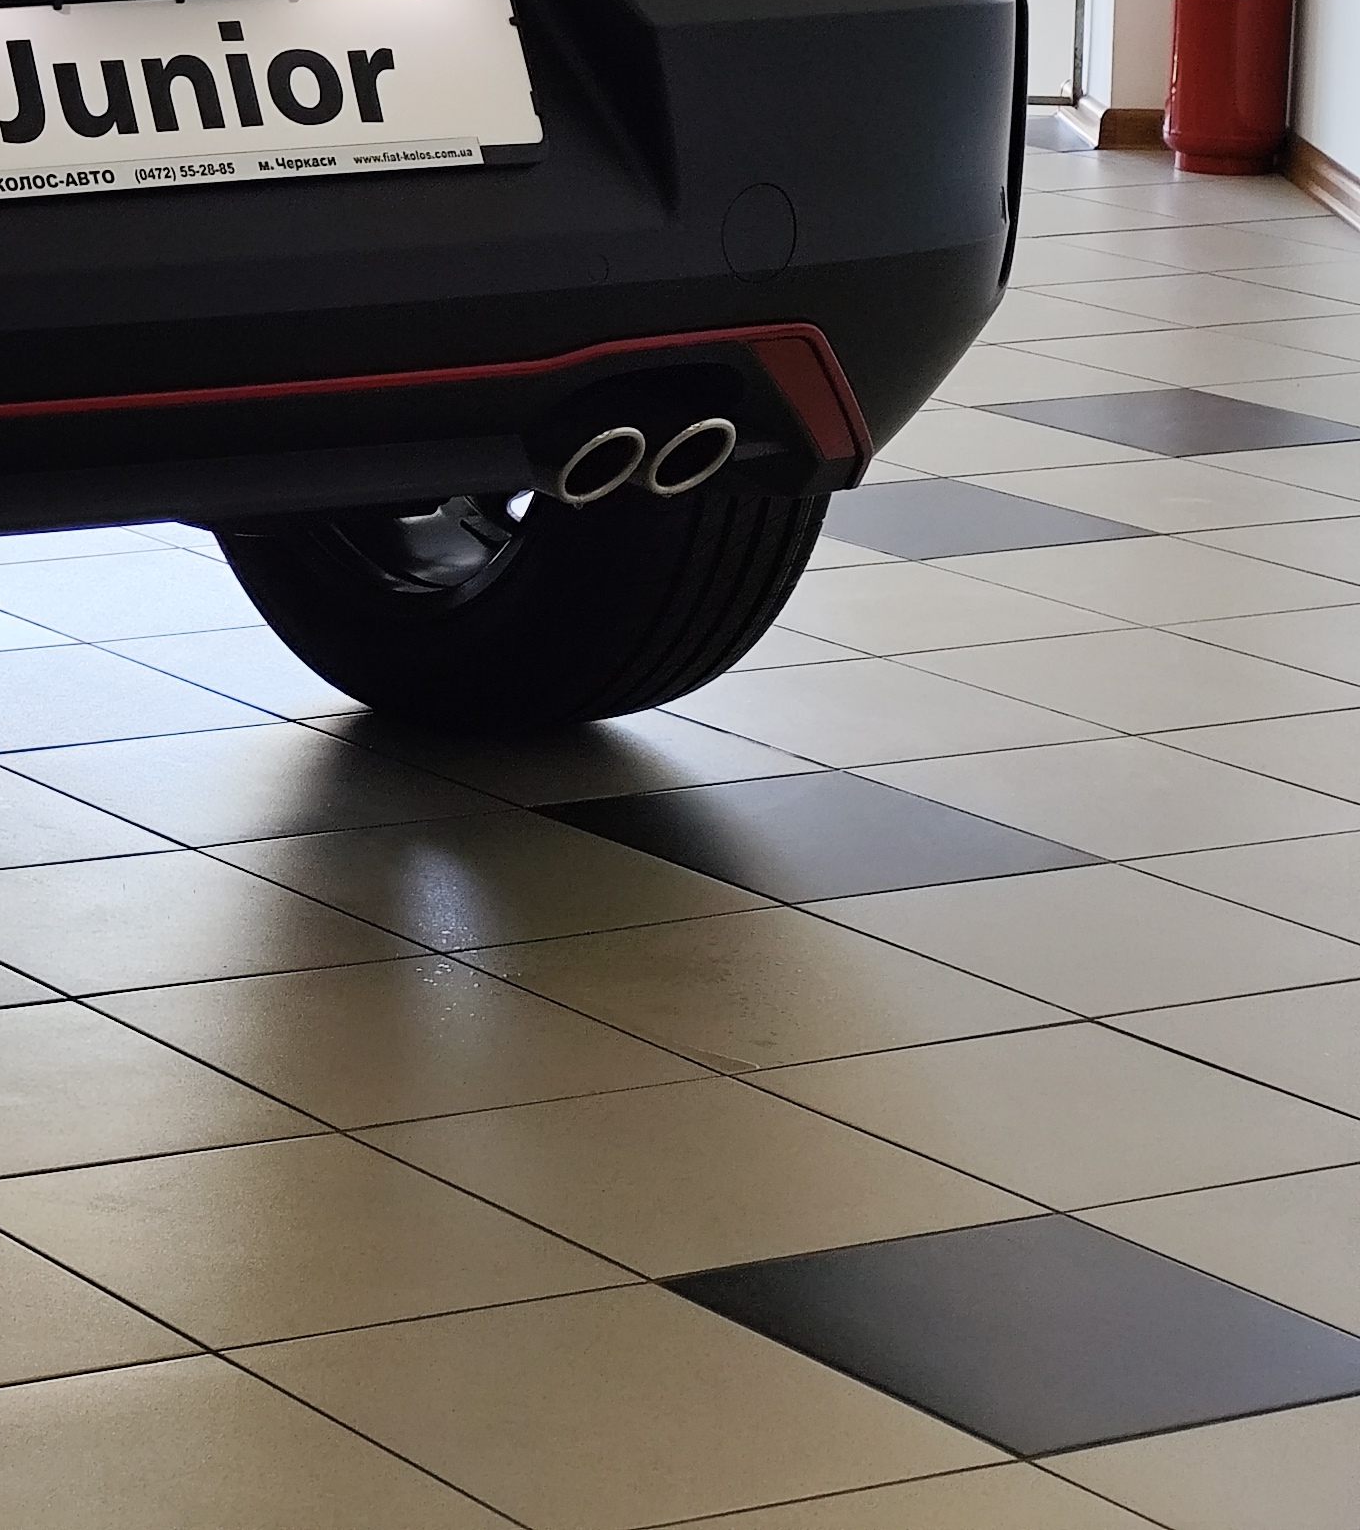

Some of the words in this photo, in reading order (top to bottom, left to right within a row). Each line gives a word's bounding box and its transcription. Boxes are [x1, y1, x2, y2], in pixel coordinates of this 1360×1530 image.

[0, 20, 395, 144] Junior
[135, 166, 177, 185] (0472)
[180, 163, 235, 178] 55-28-85
[275, 156, 337, 171] Черкаси
[353, 147, 474, 165] www.fiat-kolos.com.ua
